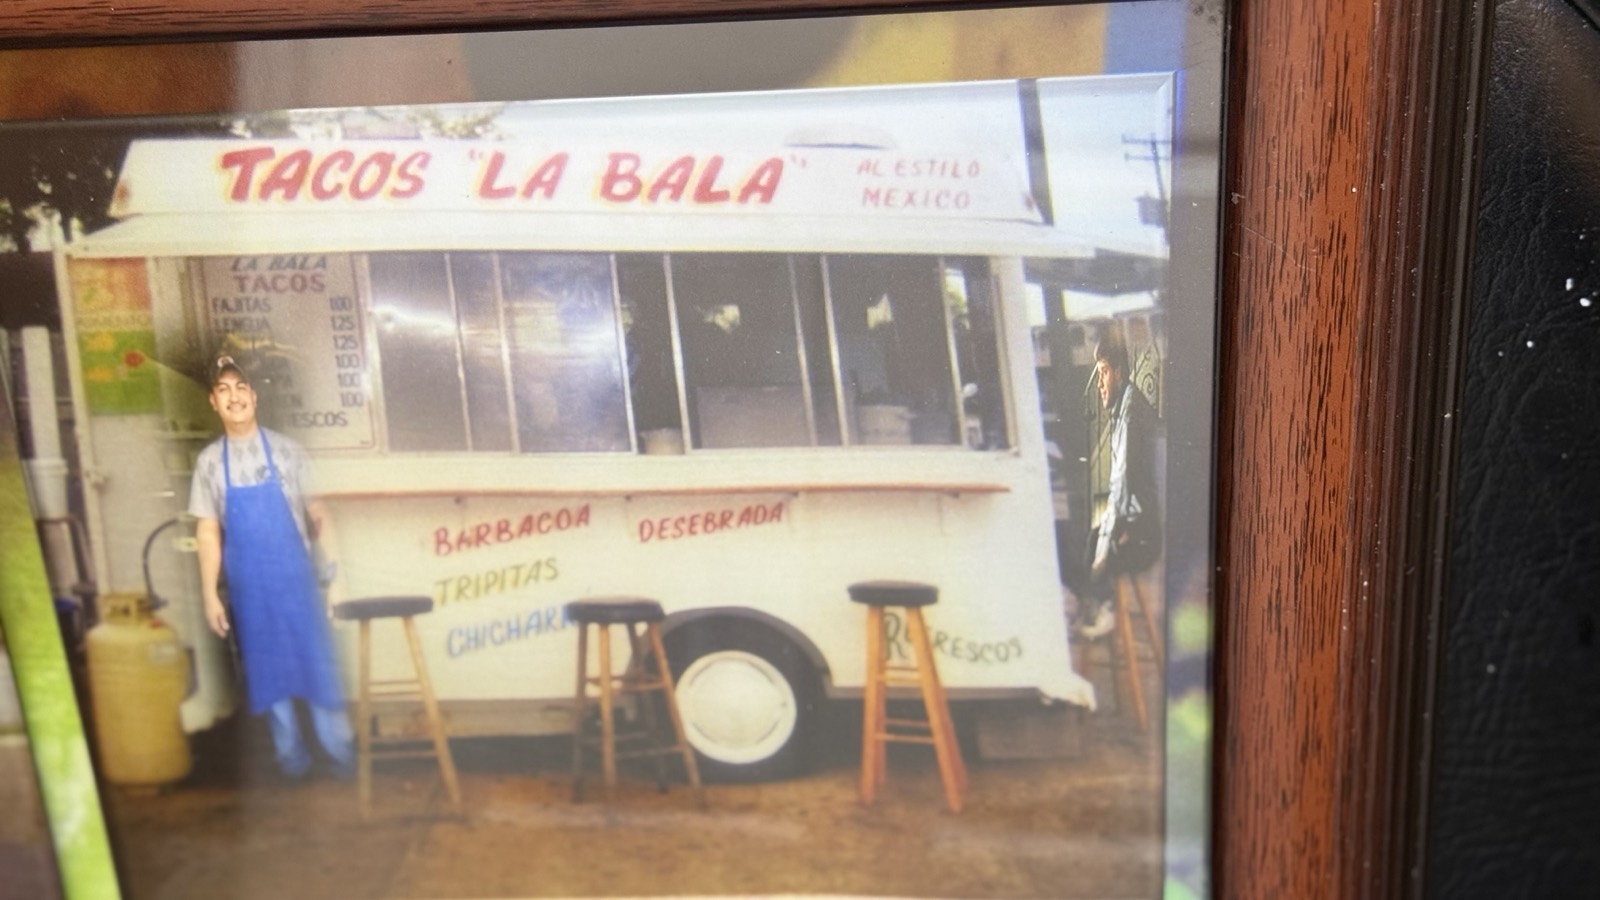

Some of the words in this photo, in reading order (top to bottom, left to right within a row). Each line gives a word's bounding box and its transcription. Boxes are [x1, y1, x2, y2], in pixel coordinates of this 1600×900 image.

[220, 147, 430, 202] TACOS
[857, 159, 884, 176] AL
[895, 158, 981, 178] ESTILO
[862, 187, 970, 209] MEXICO
[234, 272, 326, 293] TACOS
[433, 504, 592, 557] BARBACOA
[639, 501, 786, 543] DESEBRADA
[435, 557, 560, 607] TRIPITAS
